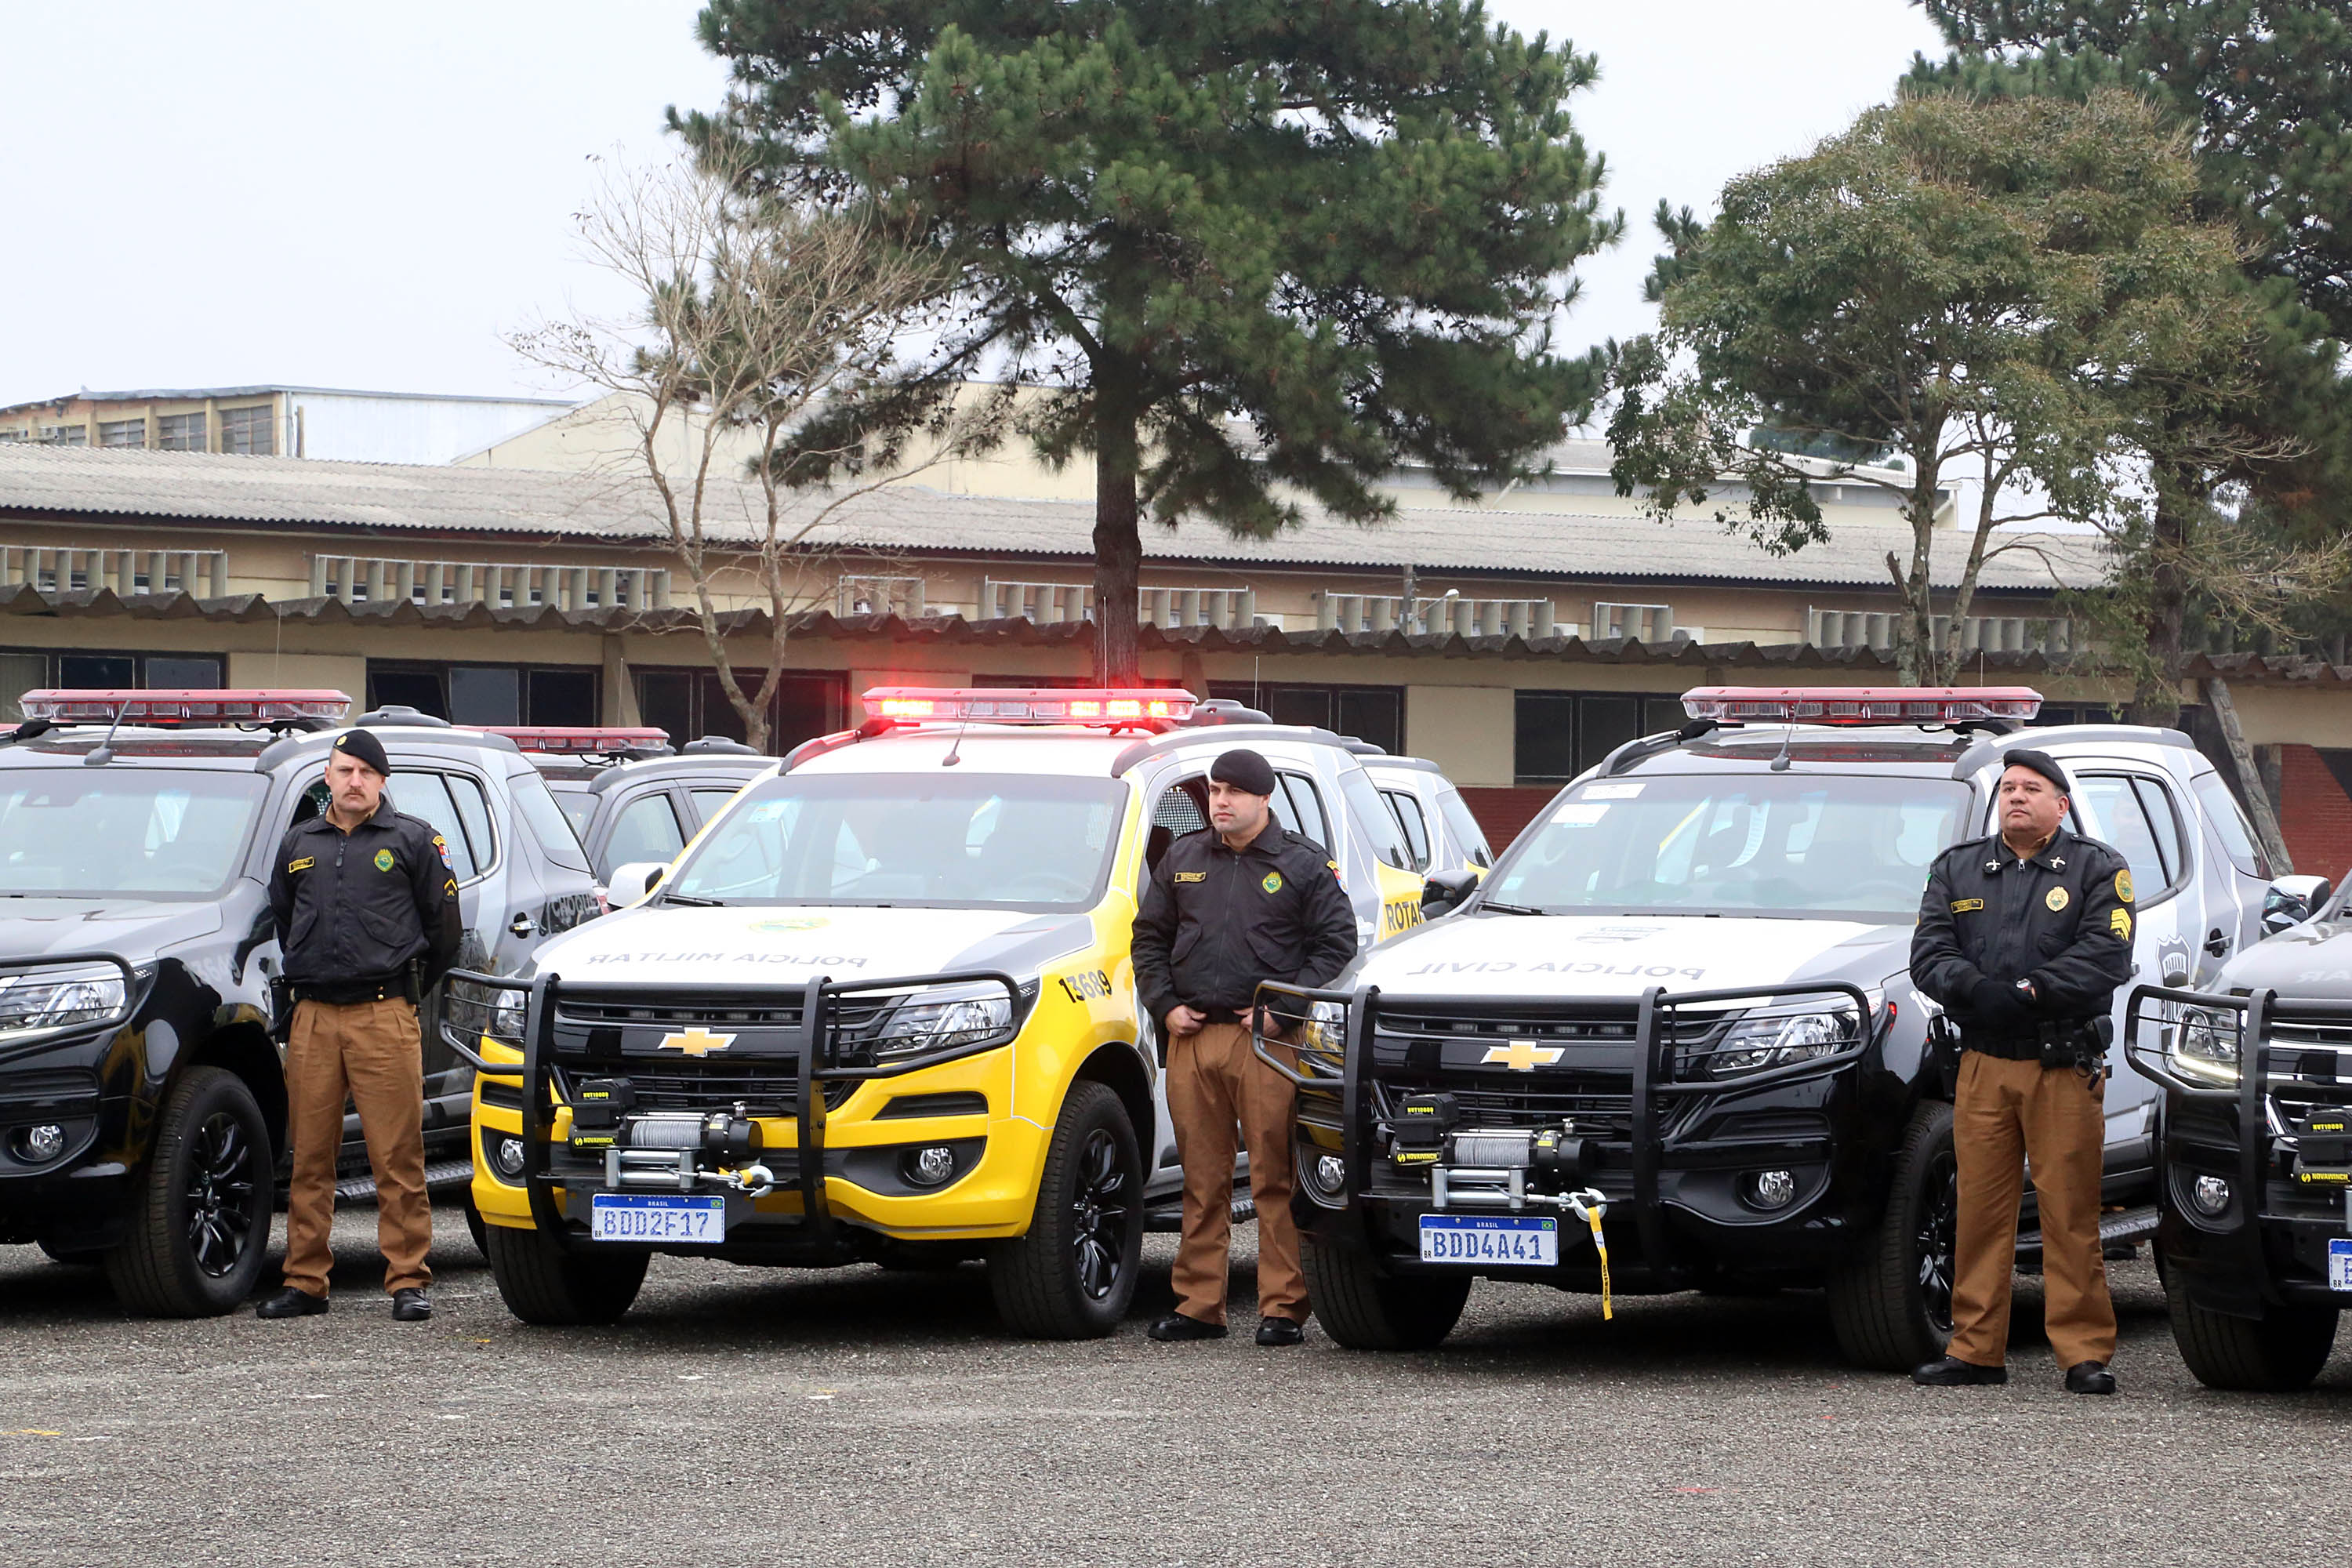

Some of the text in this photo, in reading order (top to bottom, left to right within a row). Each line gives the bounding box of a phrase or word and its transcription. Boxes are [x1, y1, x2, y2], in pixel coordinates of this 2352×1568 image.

[1058, 969, 1112, 1004] 13689
[604, 1210, 709, 1236] BDD2F17
[1424, 1250, 1432, 1258] BR
[1433, 1232, 1542, 1260] BDD4A41
[2333, 1279, 2342, 1288] BR
